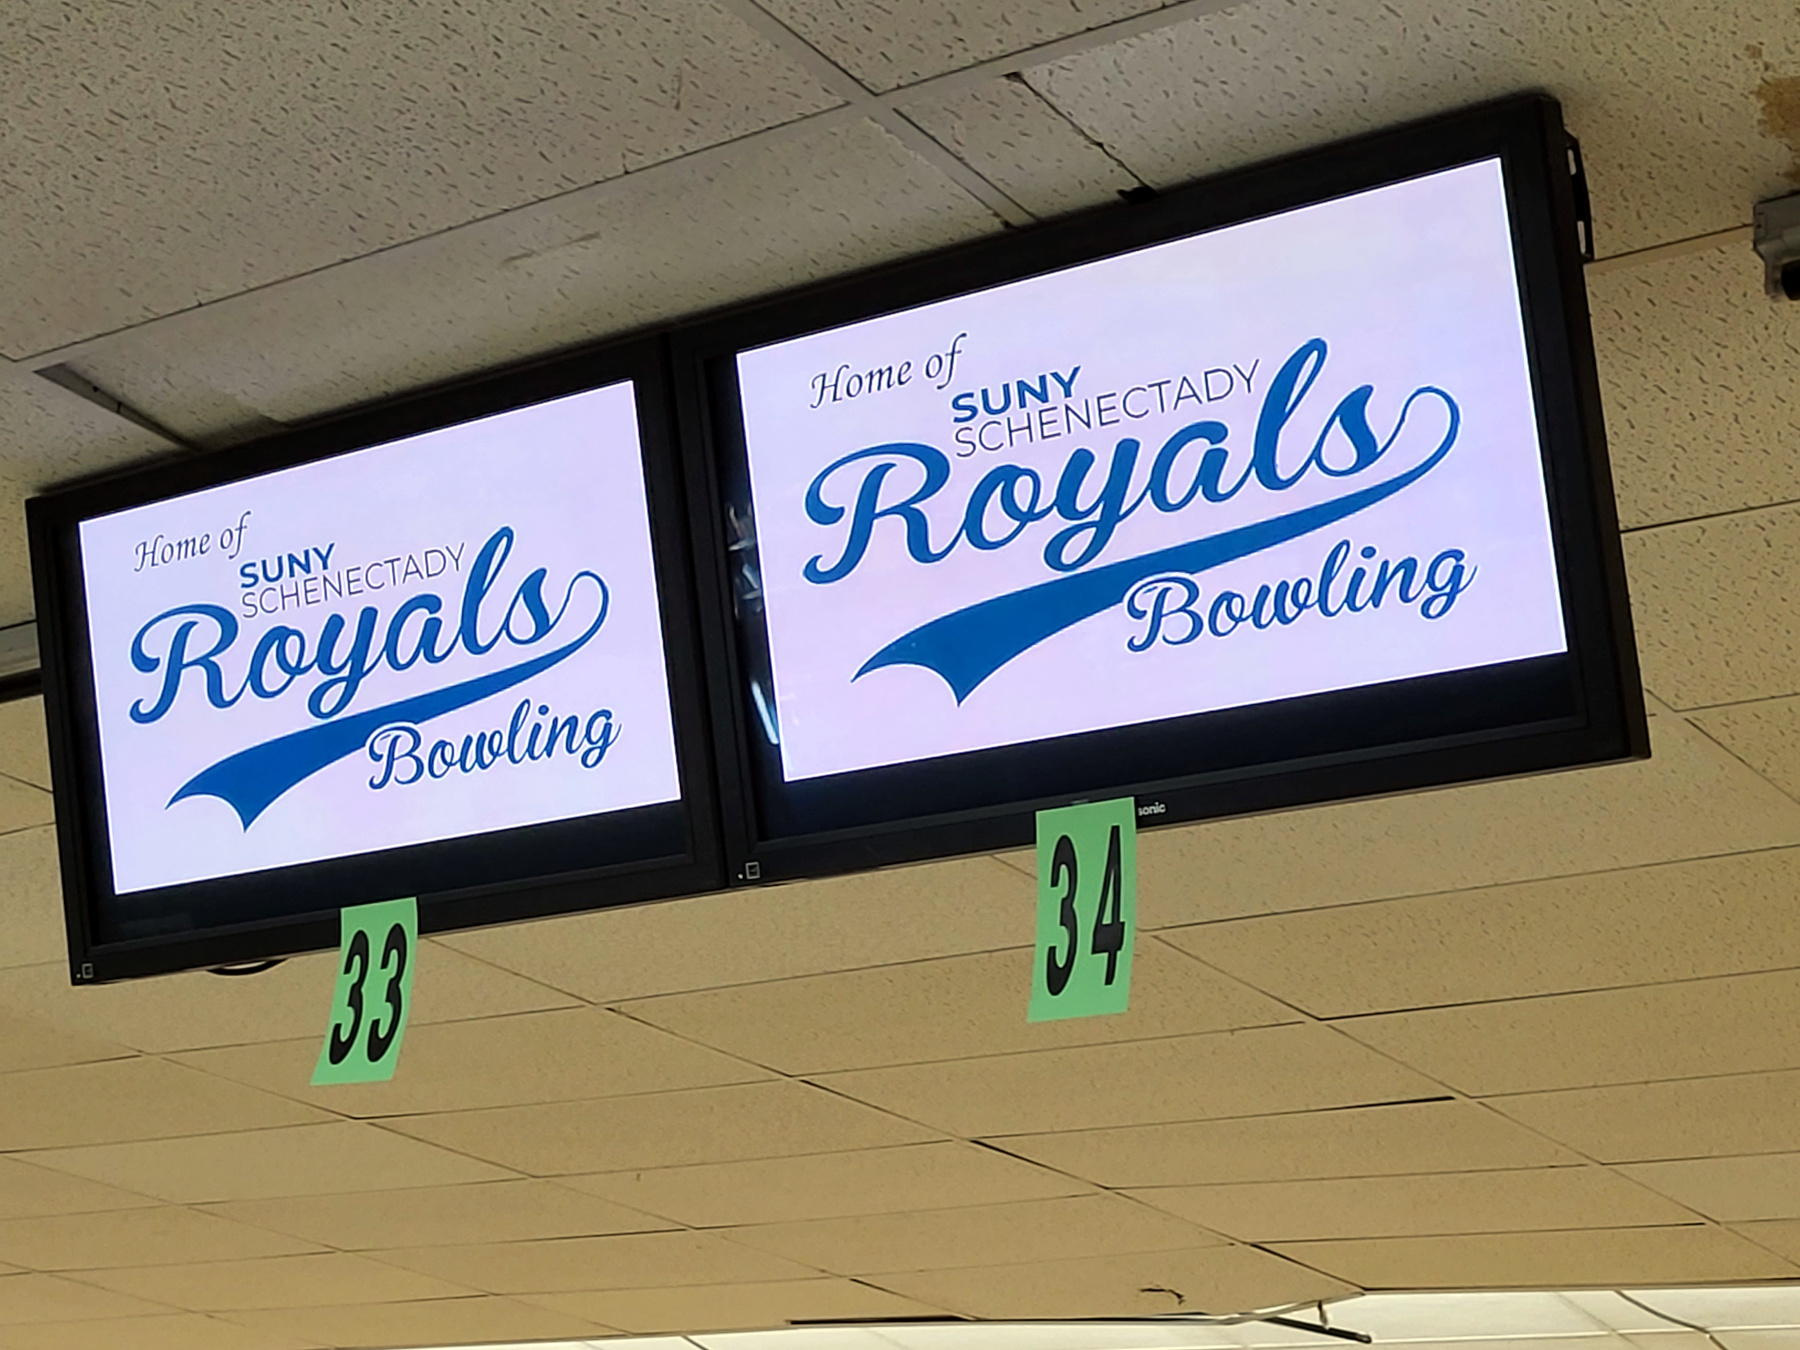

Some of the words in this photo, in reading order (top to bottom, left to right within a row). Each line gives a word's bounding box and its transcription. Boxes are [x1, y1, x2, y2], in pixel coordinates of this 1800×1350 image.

[810, 362, 912, 410] Home
[923, 332, 968, 391] of
[952, 365, 1082, 424] SUNY
[955, 358, 1260, 459] SCHENECTADY
[803, 337, 1385, 584] Royals
[133, 534, 211, 572] Home
[218, 511, 252, 558] of
[239, 542, 336, 589] SUNY
[241, 542, 466, 619] SCHENECTADY
[129, 526, 562, 724] Royals
[1125, 540, 1478, 653] Bowling
[367, 698, 622, 790] Bowling
[1045, 825, 1126, 997] 34
[328, 923, 408, 1066] 33
